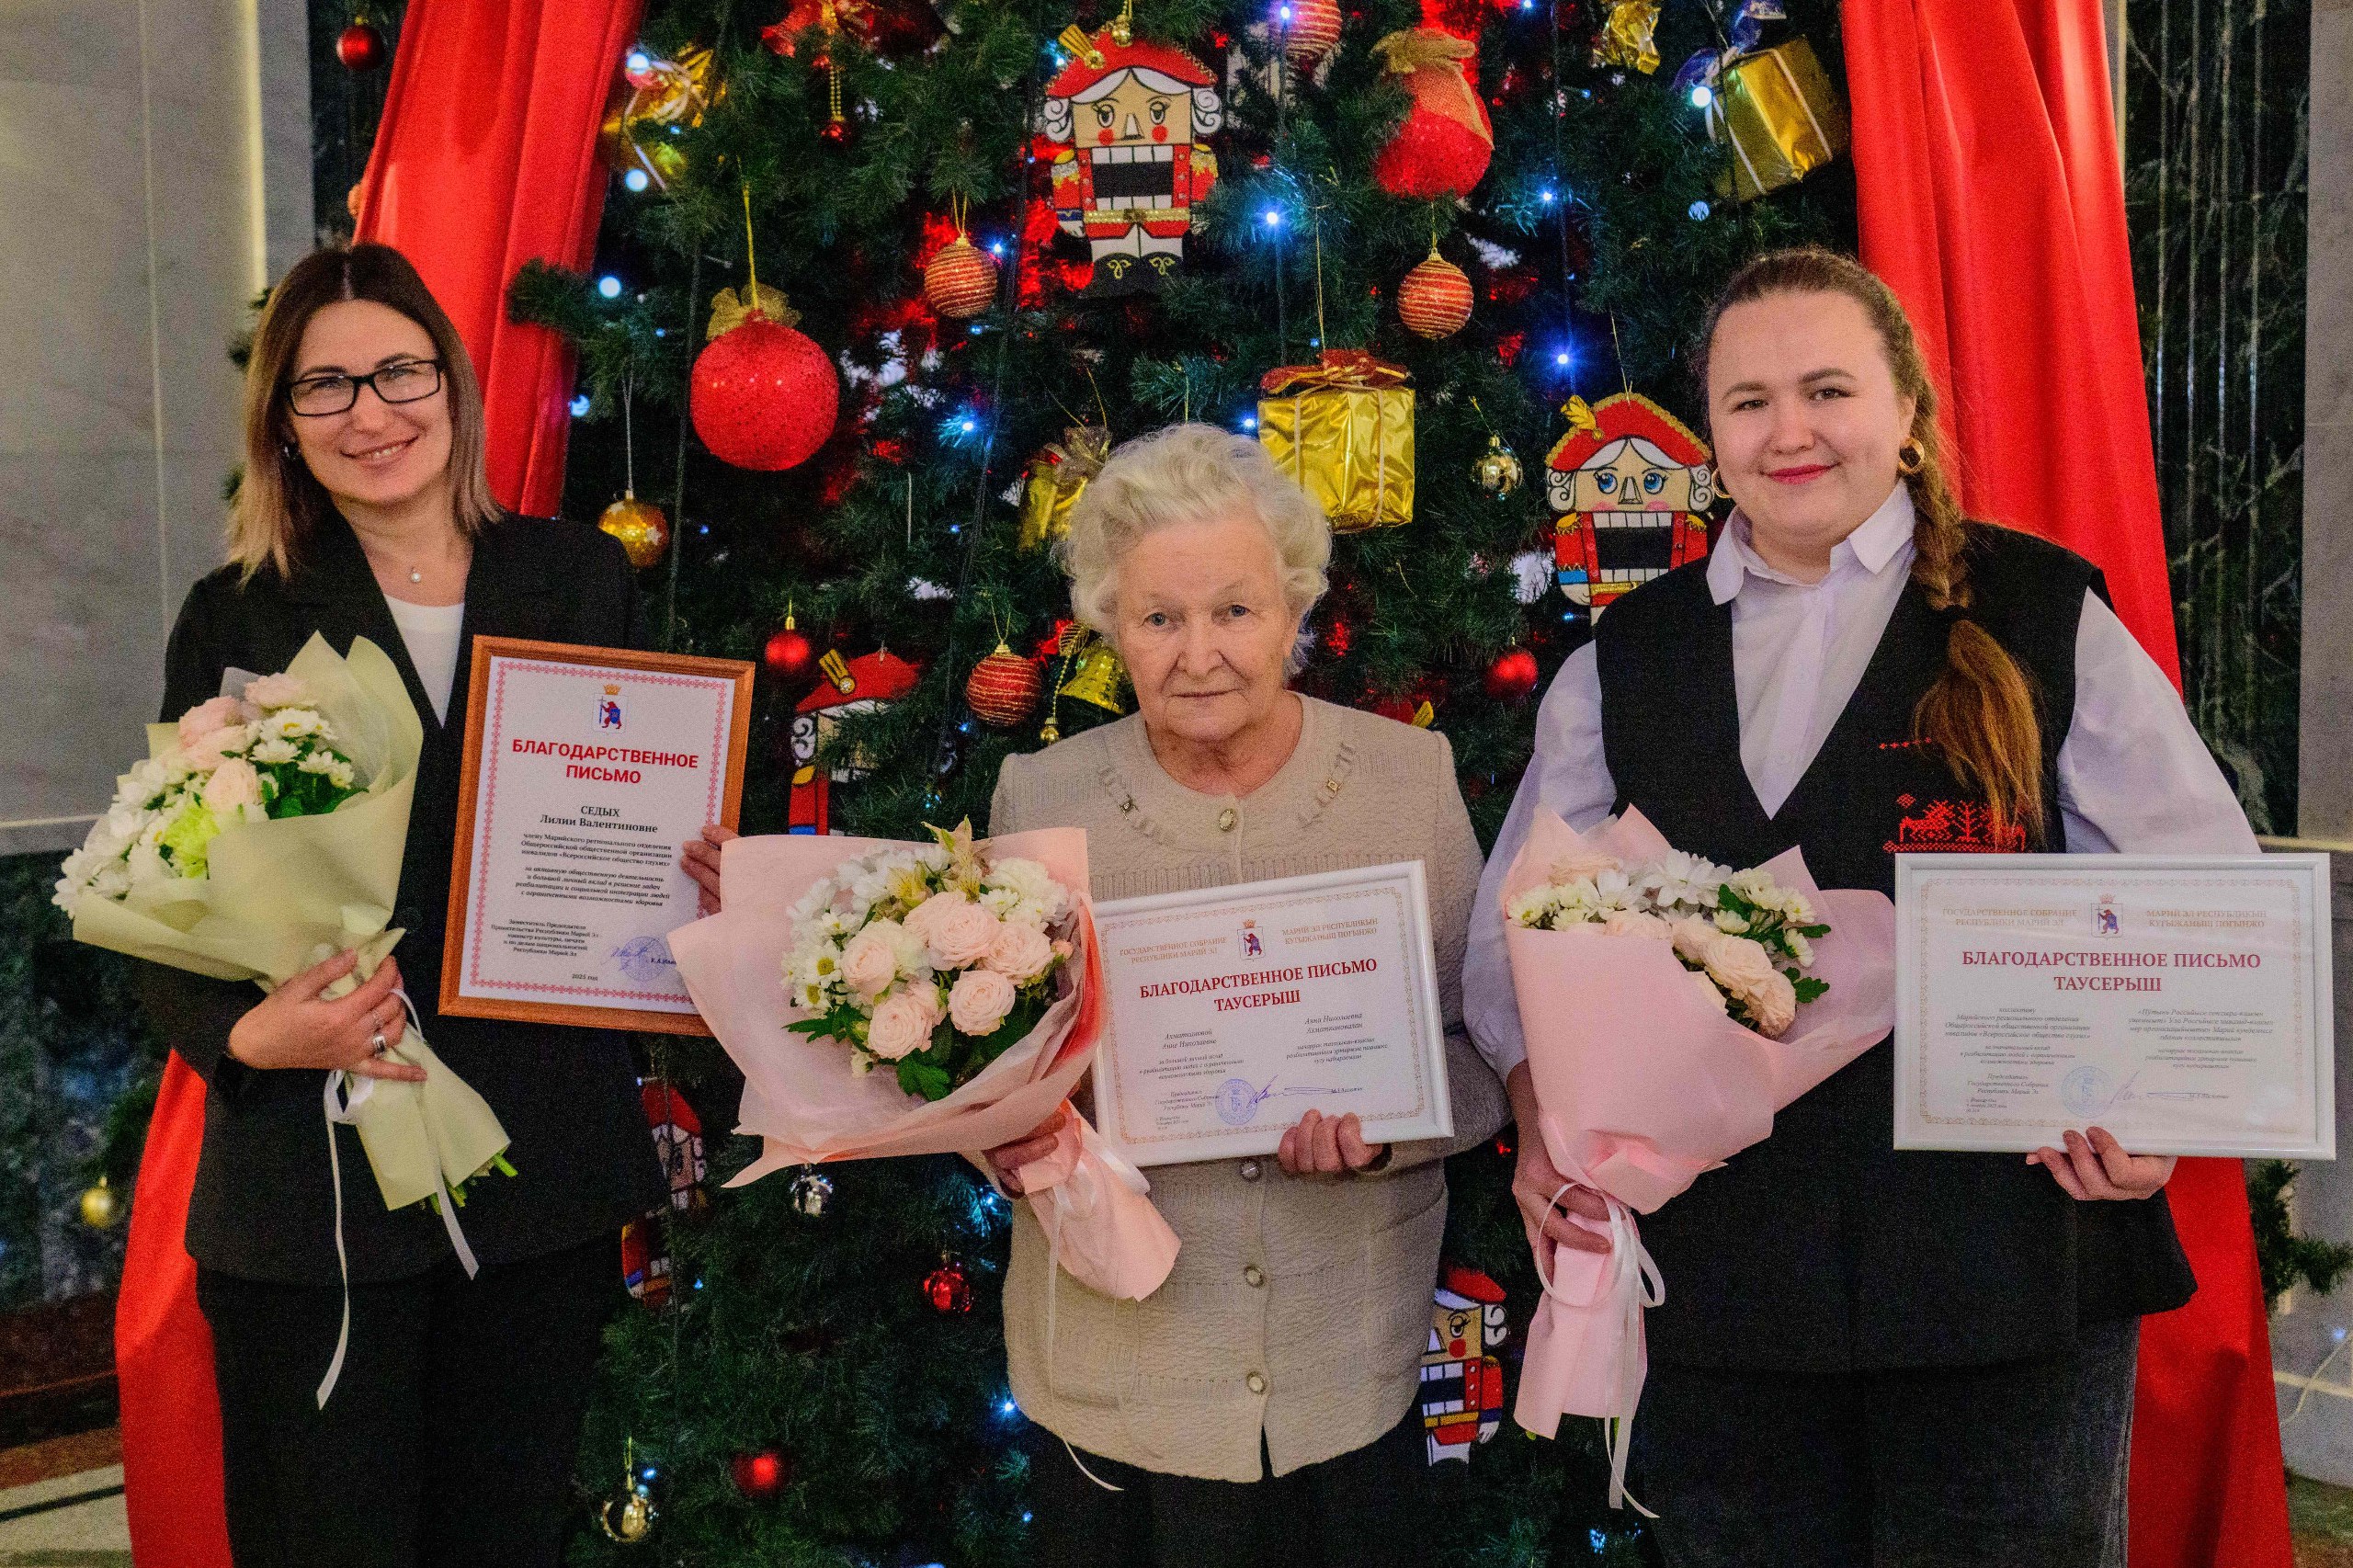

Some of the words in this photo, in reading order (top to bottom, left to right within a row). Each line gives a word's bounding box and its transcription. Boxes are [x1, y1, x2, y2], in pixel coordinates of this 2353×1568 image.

[512, 739, 698, 767] БЛАГОДАРСТВЕННОЕ
[566, 765, 641, 783] ПИСЬМО
[580, 805, 620, 817] СЕДЫХ
[540, 814, 575, 825] Лилии
[579, 817, 657, 833] Валентиновне
[544, 834, 585, 843] Марийского
[585, 838, 636, 847] регионального
[520, 840, 577, 850] Общероссийской
[579, 845, 627, 855] общественной
[629, 850, 672, 858] организации
[559, 851, 610, 861] «Всероссийское
[568, 869, 617, 878] общественную
[618, 873, 664, 882] деятельность
[515, 881, 563, 891] реабилитации
[526, 891, 577, 900] ограниченными
[578, 895, 633, 904] возможностями
[1942, 908, 2027, 916] ГОСУДАРСТВЕННОЕ
[1955, 918, 2014, 926] РЕСПУБЛИКИ
[2017, 918, 2050, 926] МАРИЙ
[1281, 926, 1309, 936] МАРИЙ
[1120, 942, 1187, 956] ГОСУДАРСТВЕННОЕ
[1189, 937, 1226, 947] СОБРАНИЕ
[1131, 952, 1178, 964] РЕСПУБЛИКИ
[1179, 948, 1206, 958] МАРИЙ
[1962, 951, 2166, 967] БЛАГОДАРСТВЕННОЕ
[2174, 953, 2260, 968] ПИСЬМО
[1140, 967, 1302, 998] БЛАГОДАРСТВЕННОЕ
[1308, 958, 1377, 978] ПИСЬМО
[2053, 976, 2161, 992] ТАУСЕРЫШ
[1214, 990, 1300, 1011] ТАУСЕРЫШ
[1323, 1013, 1362, 1022] Николаевна
[1179, 1040, 1216, 1048] Николаевне
